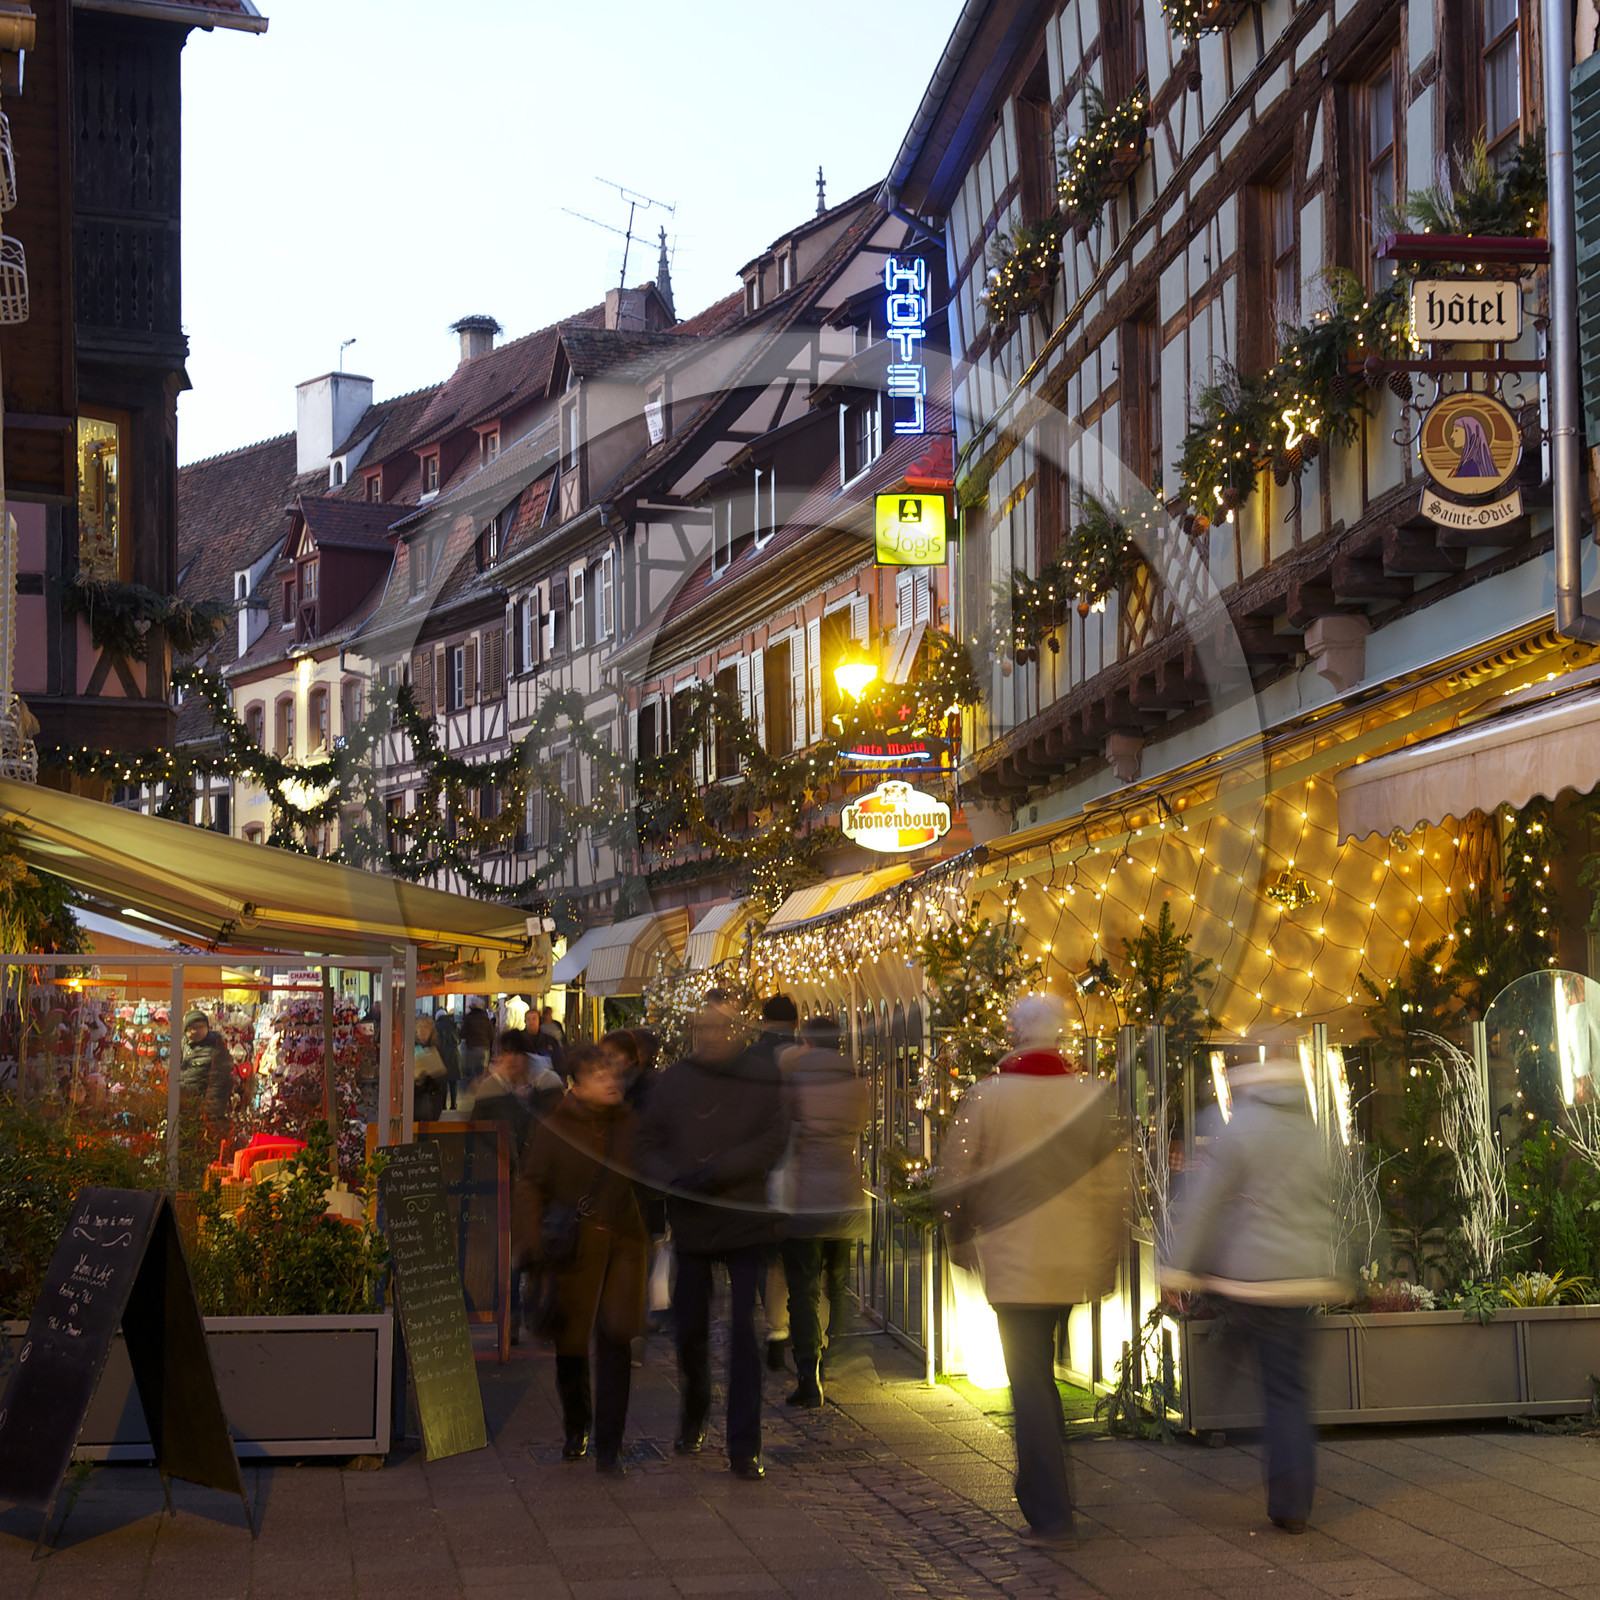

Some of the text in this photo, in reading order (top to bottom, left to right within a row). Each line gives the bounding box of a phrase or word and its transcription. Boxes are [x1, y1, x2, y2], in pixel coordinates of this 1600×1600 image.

[1426, 289, 1506, 331] hôtel
[885, 257, 926, 435] HOTEL
[1427, 500, 1515, 527] Sainte-Odile
[881, 525, 941, 559] Logis
[887, 740, 926, 754] Maria
[847, 807, 947, 832] Kronenbourg
[290, 972, 320, 980] CHAPKAS
